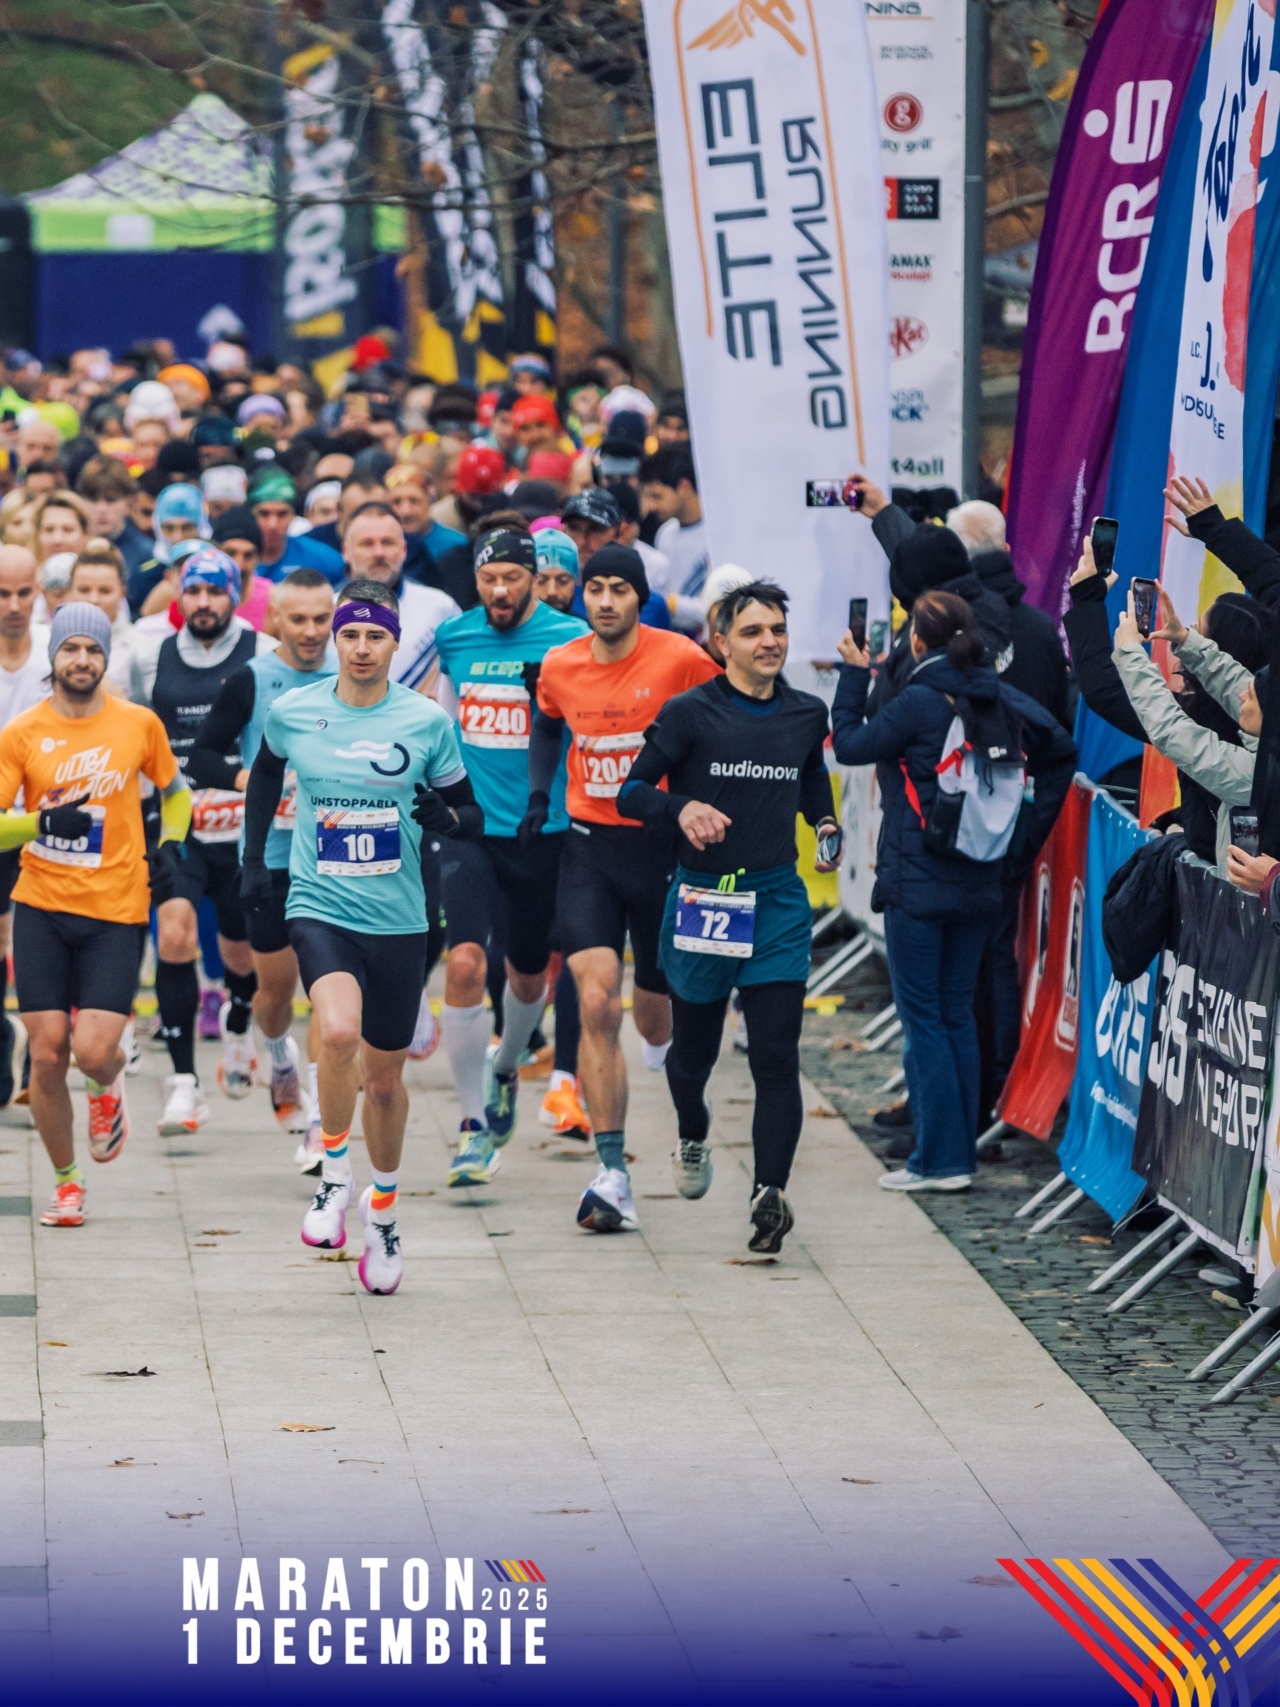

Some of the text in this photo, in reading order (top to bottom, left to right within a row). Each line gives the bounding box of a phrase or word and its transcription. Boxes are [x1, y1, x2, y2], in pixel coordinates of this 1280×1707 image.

[1084, 176, 1160, 354] BCR
[466, 704, 527, 735] 2240
[54, 744, 113, 784] ULTRA
[588, 754, 638, 783] 204
[710, 760, 799, 780] audionova
[311, 796, 399, 808] UNSTOPPABLE
[342, 833, 376, 861] 10
[701, 910, 731, 940] 72
